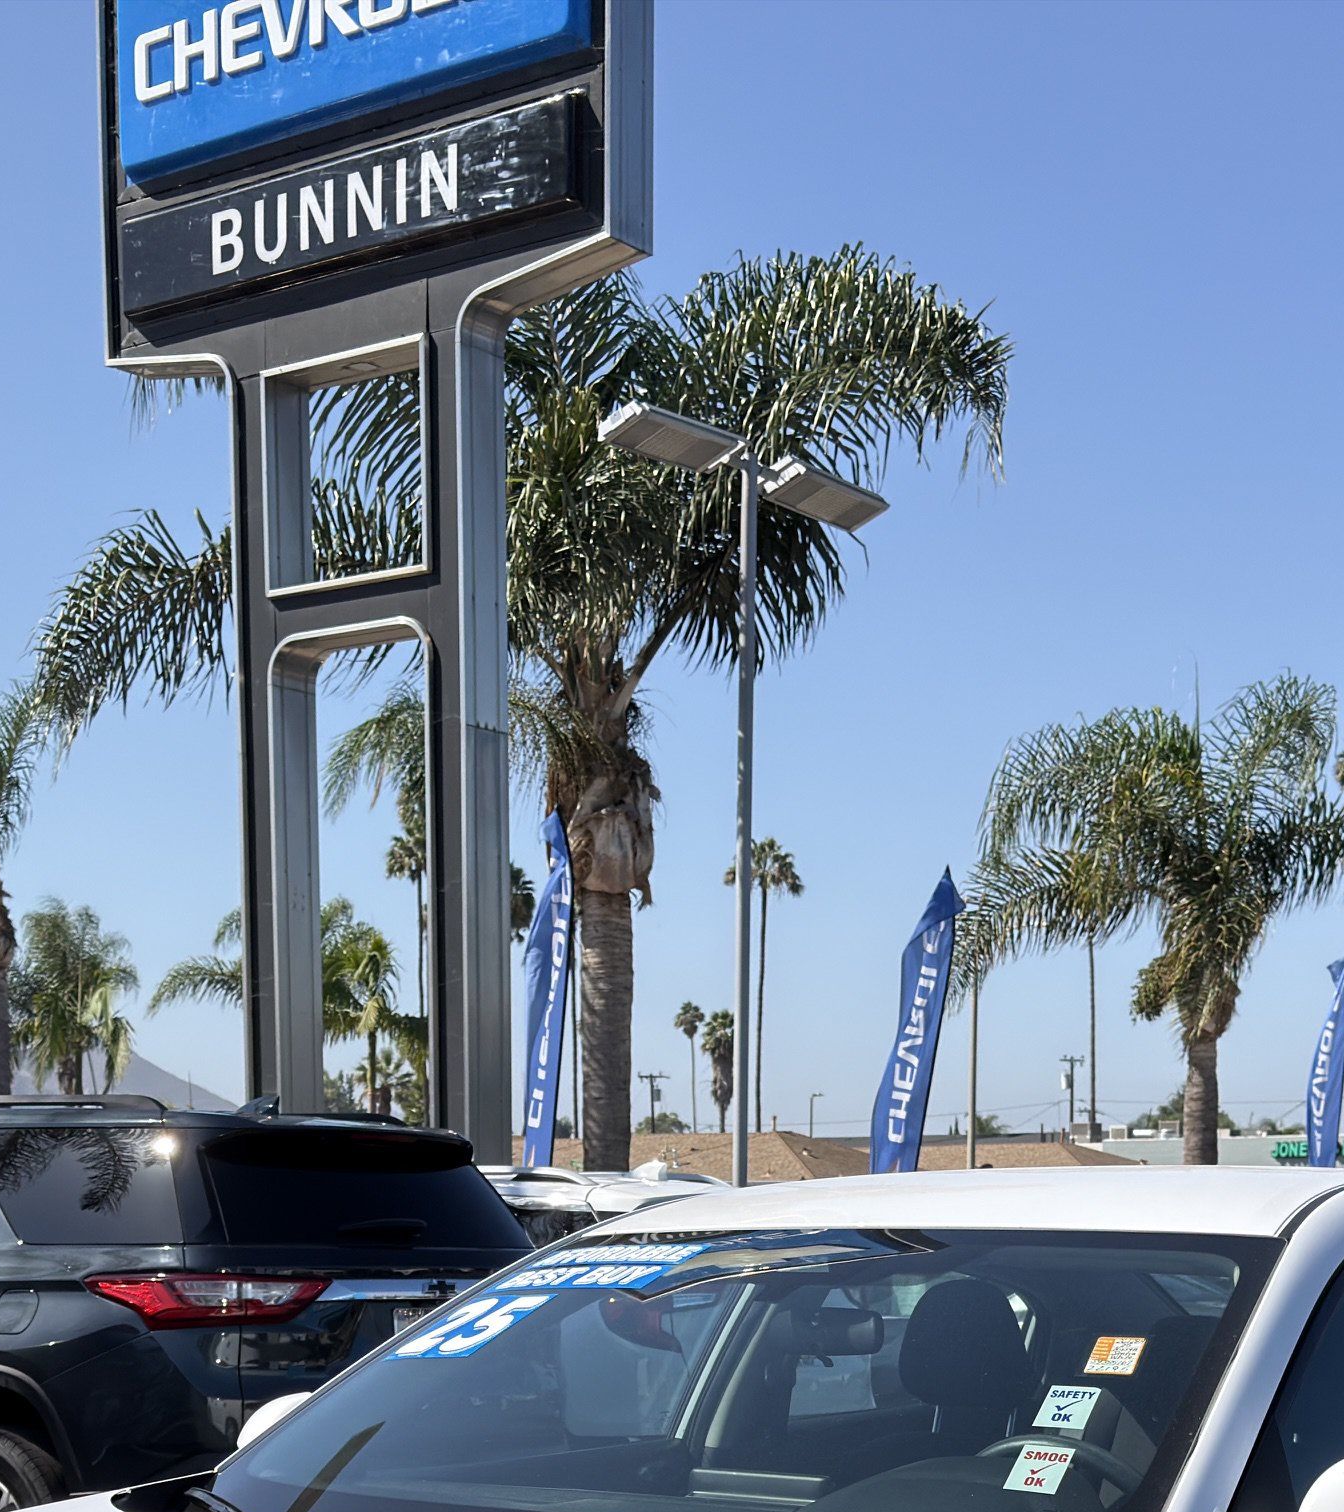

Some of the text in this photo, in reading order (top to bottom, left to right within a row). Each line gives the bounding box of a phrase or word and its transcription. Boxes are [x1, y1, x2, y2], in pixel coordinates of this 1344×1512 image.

[210, 143, 459, 275] BUNNIN
[1271, 1141, 1308, 1157] JONE
[532, 1245, 707, 1266] AFFORDABLE
[496, 1265, 662, 1289] BEST BUY
[396, 1295, 550, 1356] 25
[1050, 1389, 1096, 1400] SAFETY
[1051, 1412, 1073, 1423] OK
[1023, 1450, 1069, 1463] SMOG
[1023, 1476, 1046, 1488] OK
